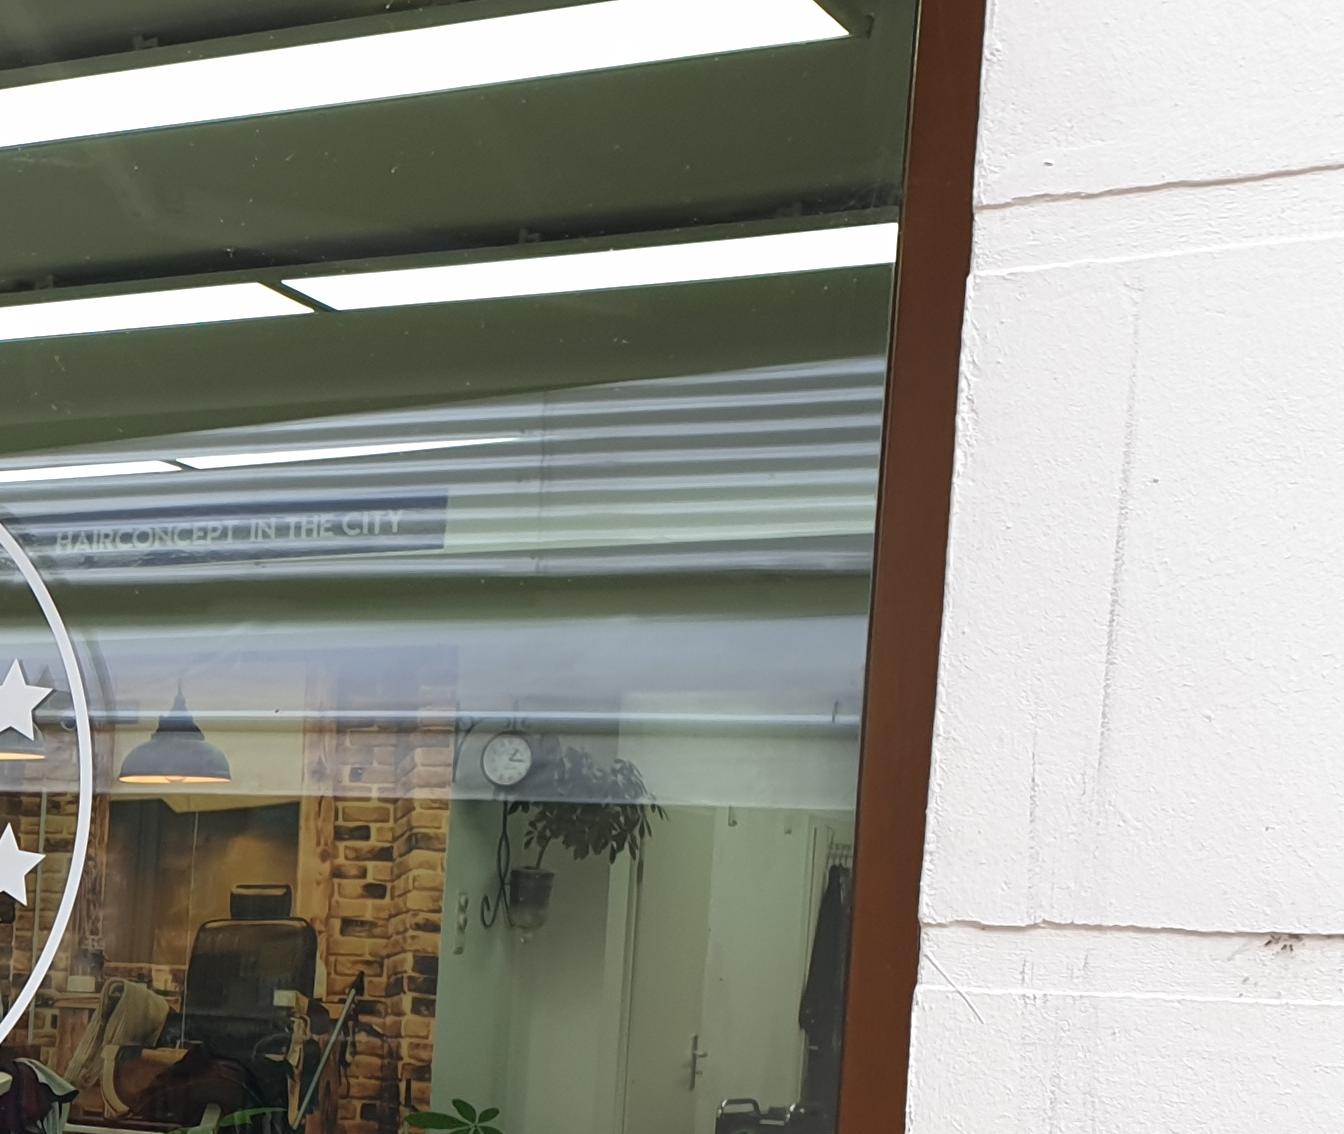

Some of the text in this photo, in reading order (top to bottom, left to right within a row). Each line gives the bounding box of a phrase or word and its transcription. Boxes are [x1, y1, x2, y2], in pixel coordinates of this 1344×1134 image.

[55, 509, 404, 554] HAIRCONCEPT IN THE CITY
